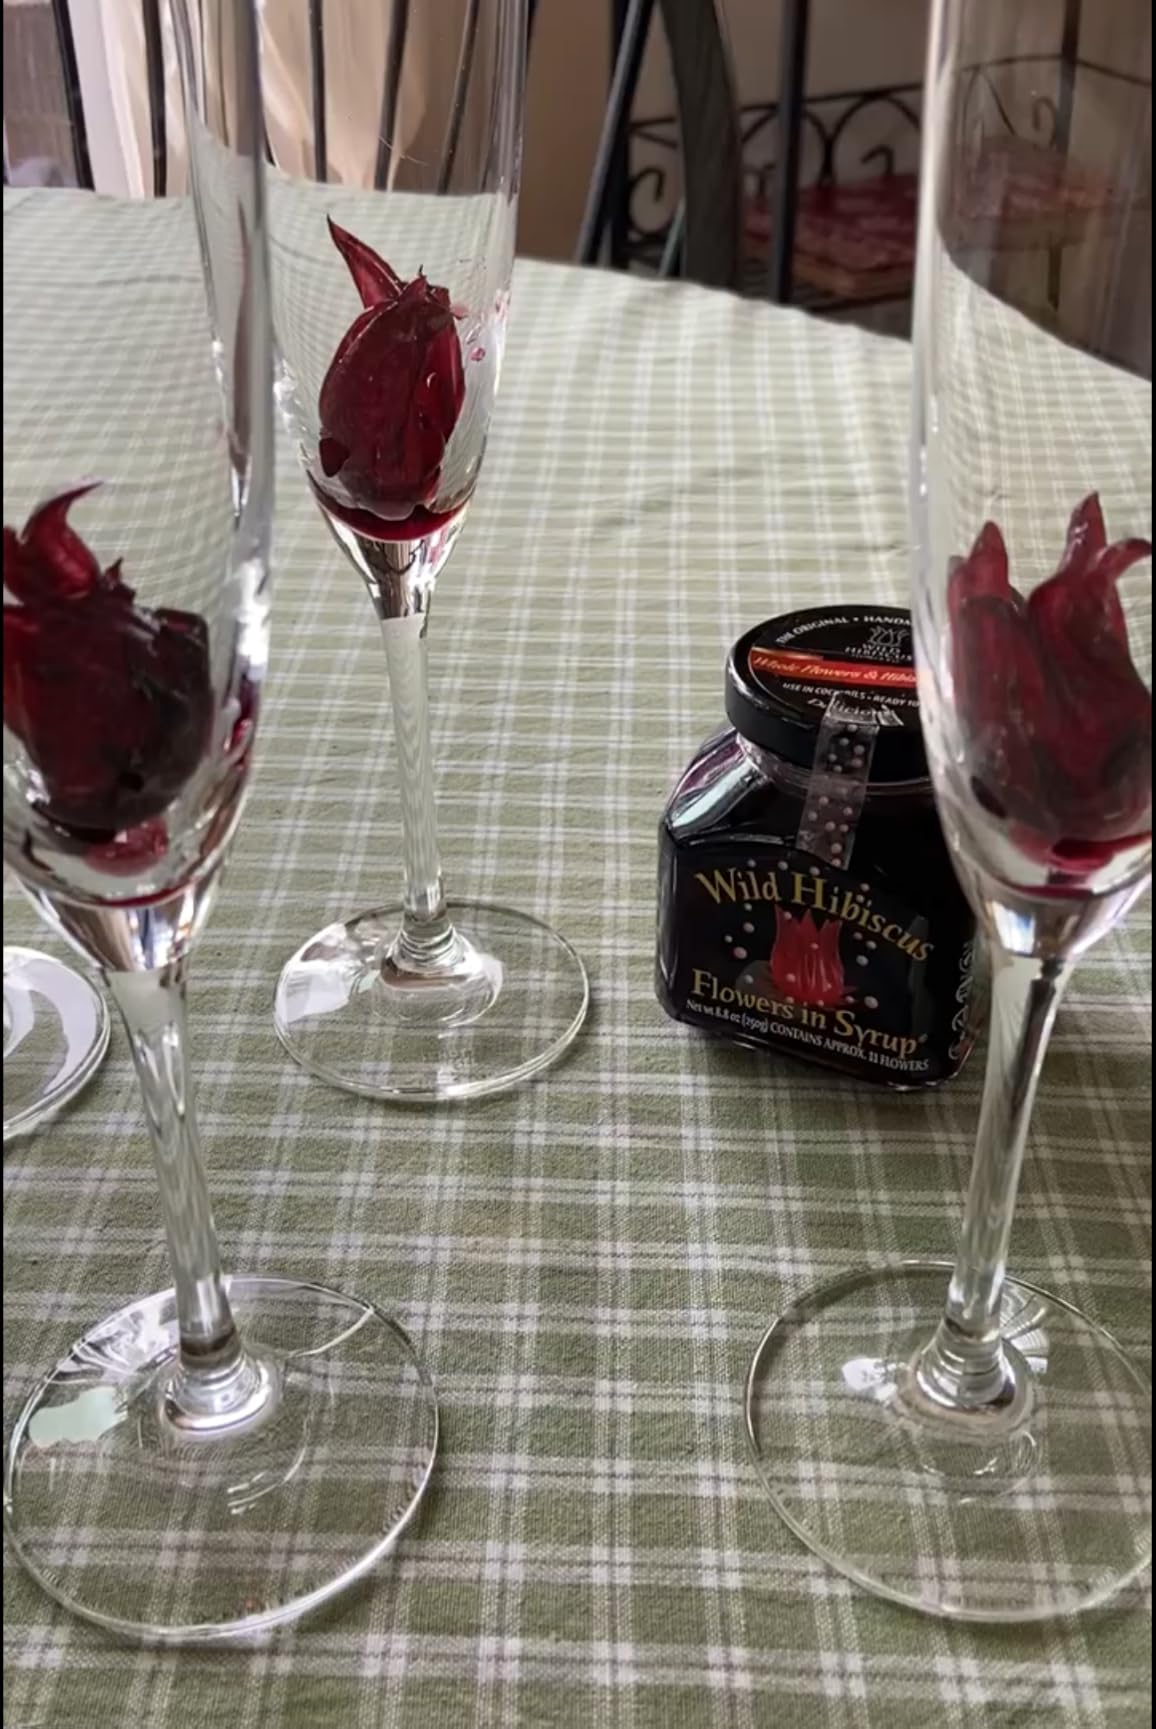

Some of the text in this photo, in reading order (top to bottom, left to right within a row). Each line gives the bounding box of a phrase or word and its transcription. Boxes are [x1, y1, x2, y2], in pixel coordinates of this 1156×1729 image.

[792, 616, 850, 635] ORIGINAL
[782, 682, 801, 692] USE
[802, 686, 814, 694] IN
[873, 694, 906, 706] READY
[801, 664, 861, 680] Flowers
[864, 671, 878, 680] &
[693, 867, 935, 961] Wild Hibiscus
[686, 999, 702, 1012] Net
[703, 1005, 714, 1016] wt
[770, 1022, 823, 1046] CONTAINS
[823, 1038, 867, 1060] APPROX.
[868, 1051, 879, 1064] 11
[880, 1054, 929, 1071] FLOWERS
[691, 968, 918, 1060] Flowers in Syrup
